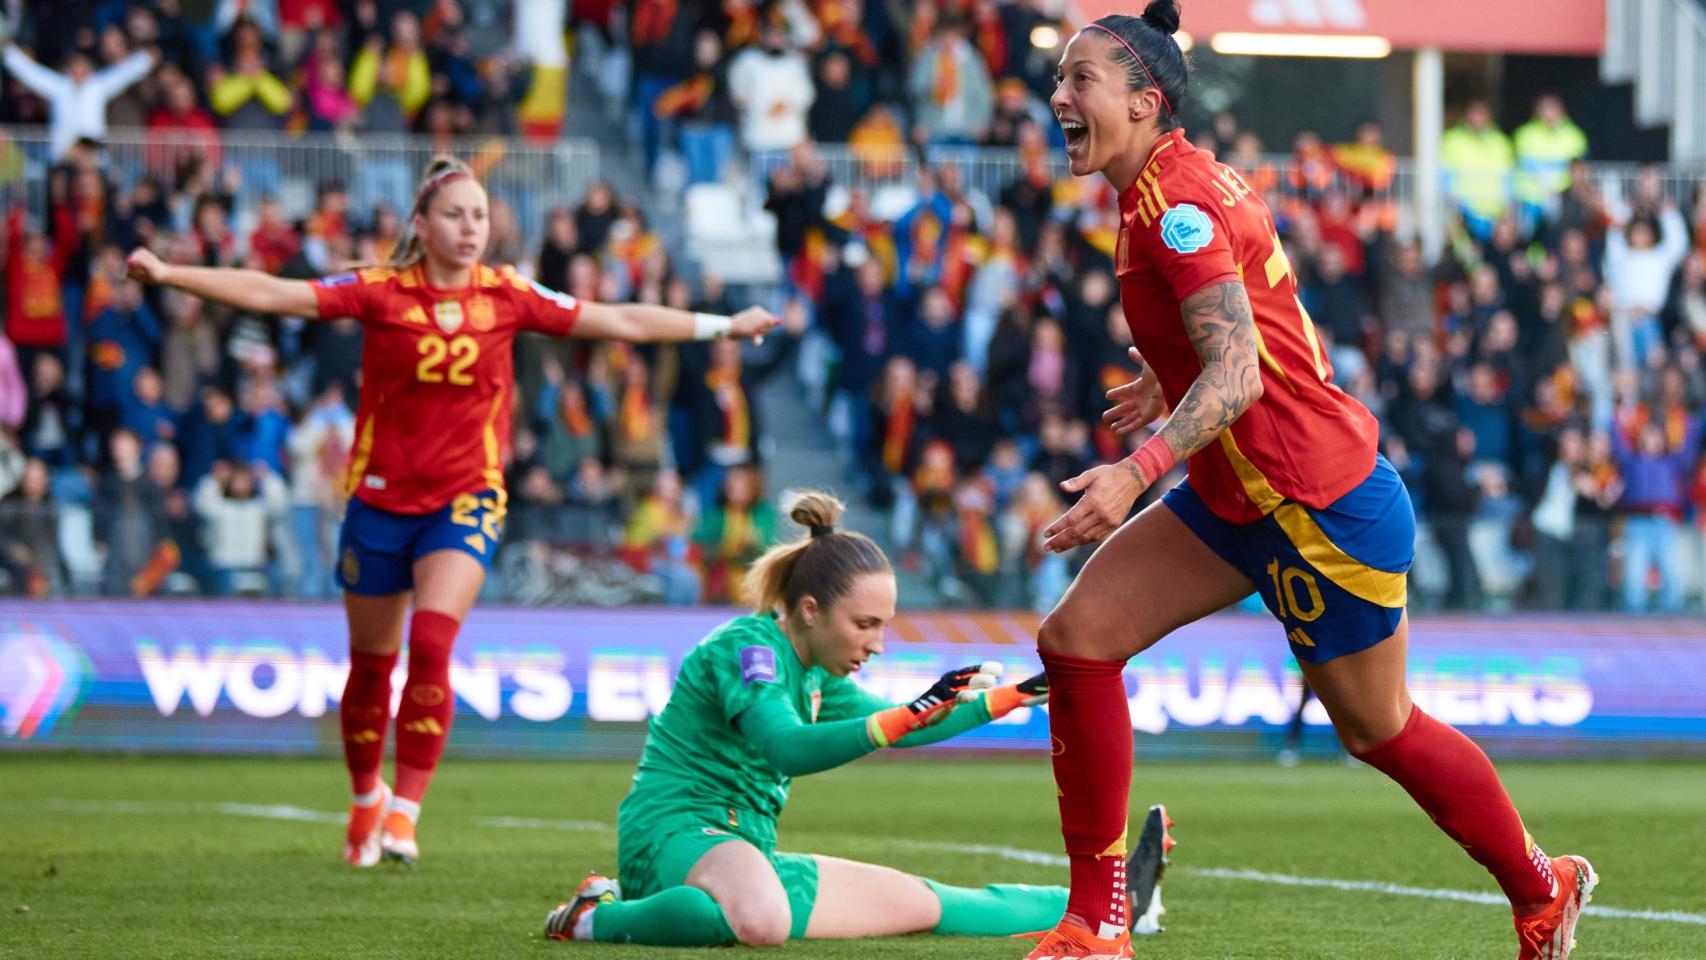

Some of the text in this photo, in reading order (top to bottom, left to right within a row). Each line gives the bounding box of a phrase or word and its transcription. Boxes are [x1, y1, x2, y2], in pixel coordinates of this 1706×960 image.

[416, 333, 480, 386] 22
[451, 493, 506, 541] 22
[1267, 556, 1326, 622] 10
[134, 637, 573, 721] WOMN'S
[1121, 653, 1594, 734] QUALIERS
